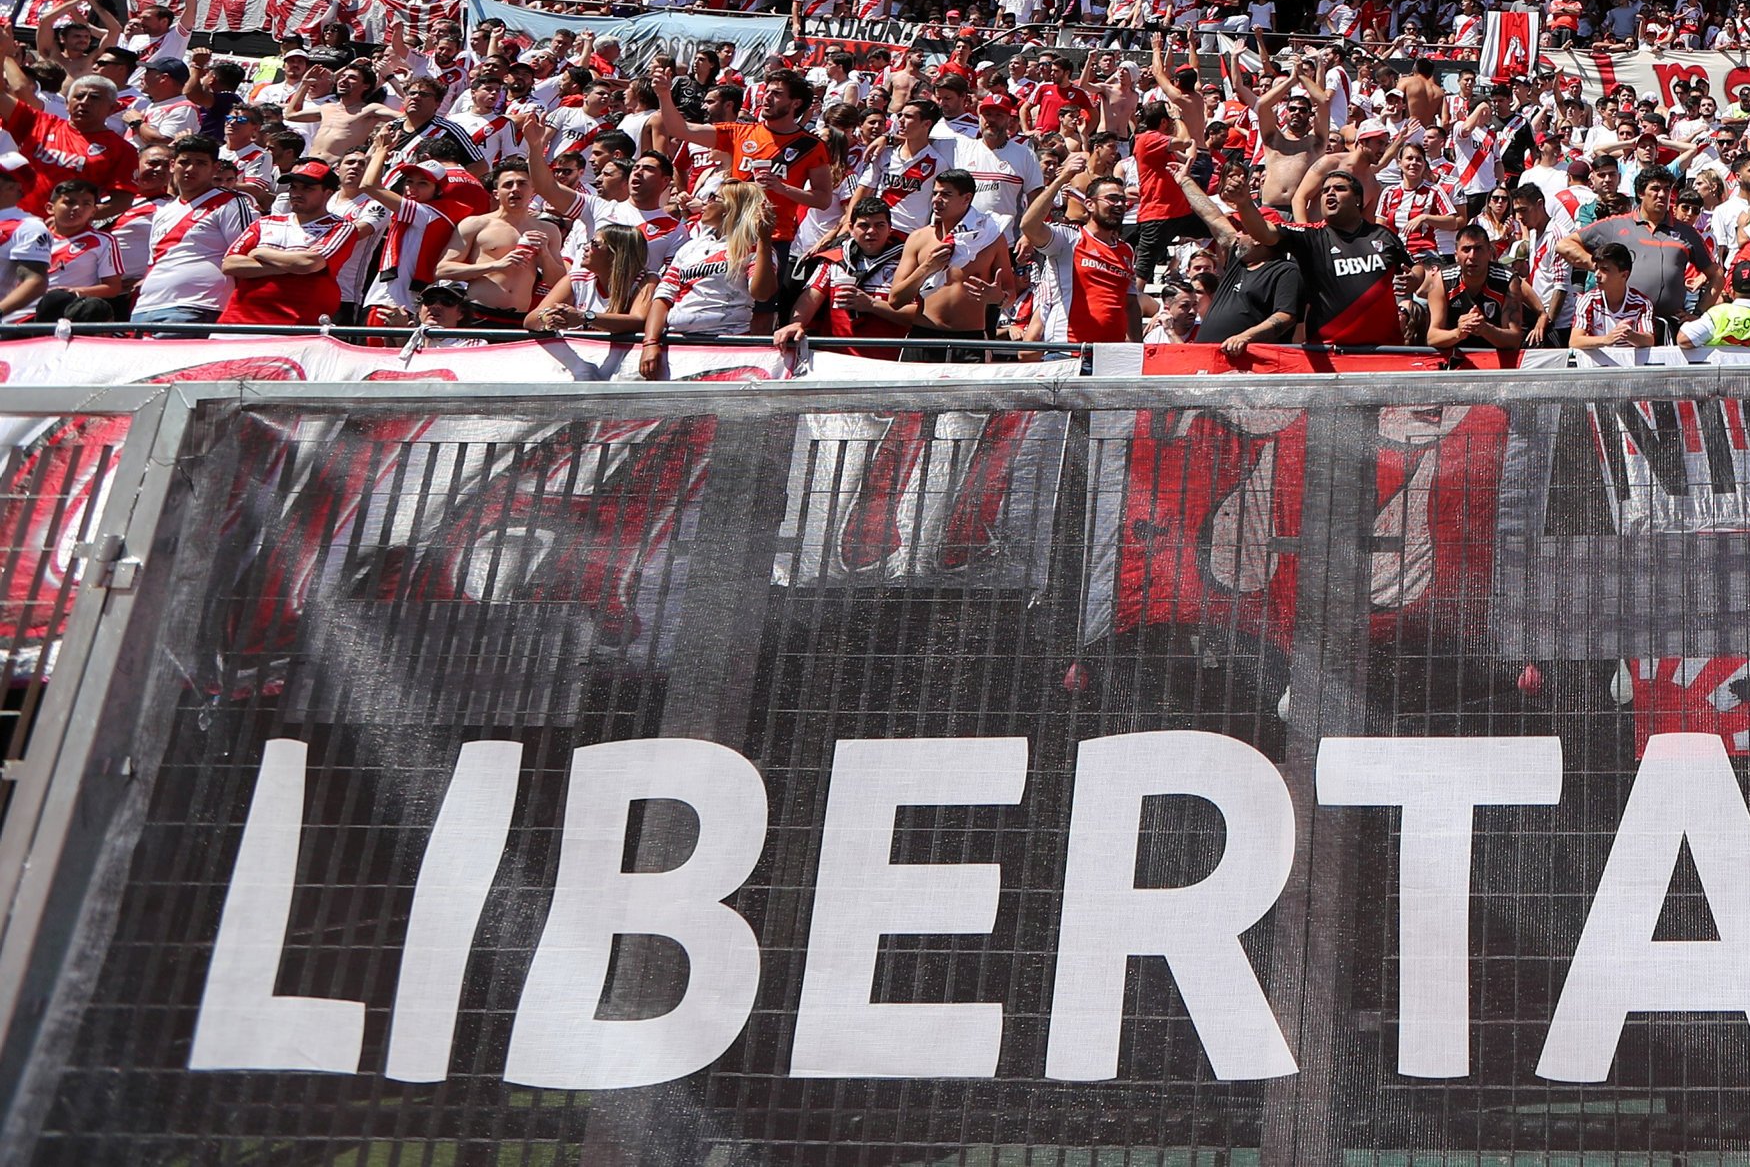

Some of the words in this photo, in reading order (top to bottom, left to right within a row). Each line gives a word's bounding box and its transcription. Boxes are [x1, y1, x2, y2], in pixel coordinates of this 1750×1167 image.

[34, 144, 87, 172] BBVA
[883, 174, 922, 191] BBVA
[1080, 258, 1108, 272] BBVA
[1334, 254, 1387, 277] BBVA
